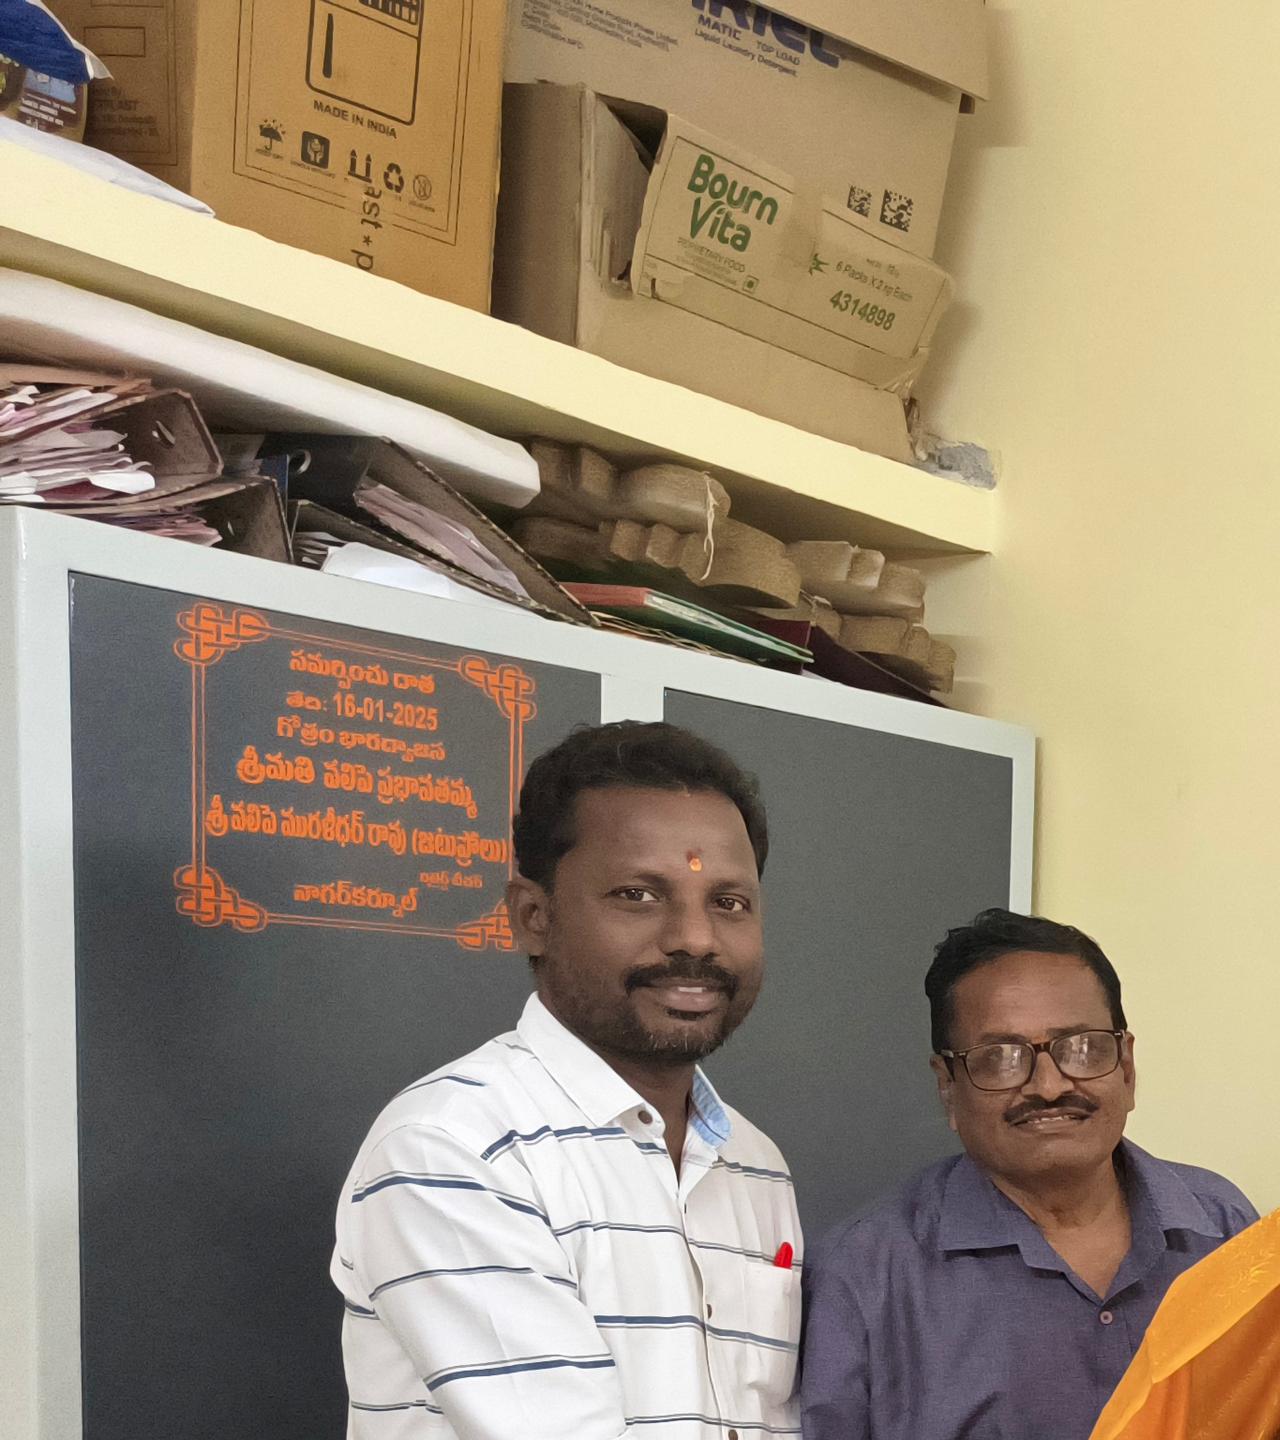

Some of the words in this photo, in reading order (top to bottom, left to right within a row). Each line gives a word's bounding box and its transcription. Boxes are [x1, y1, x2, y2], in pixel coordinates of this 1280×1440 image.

[698, 14, 742, 41] MATIC
[313, 100, 349, 122] MADE
[352, 113, 365, 128] IN
[367, 120, 398, 140] INDIA
[687, 153, 780, 226] Bourn
[690, 197, 752, 253] Vita
[829, 290, 896, 331] 4314898
[333, 690, 440, 732] 16-01-2025
[236, 745, 316, 785] శ్రీమతి
[205, 794, 229, 837] శ్రీ
